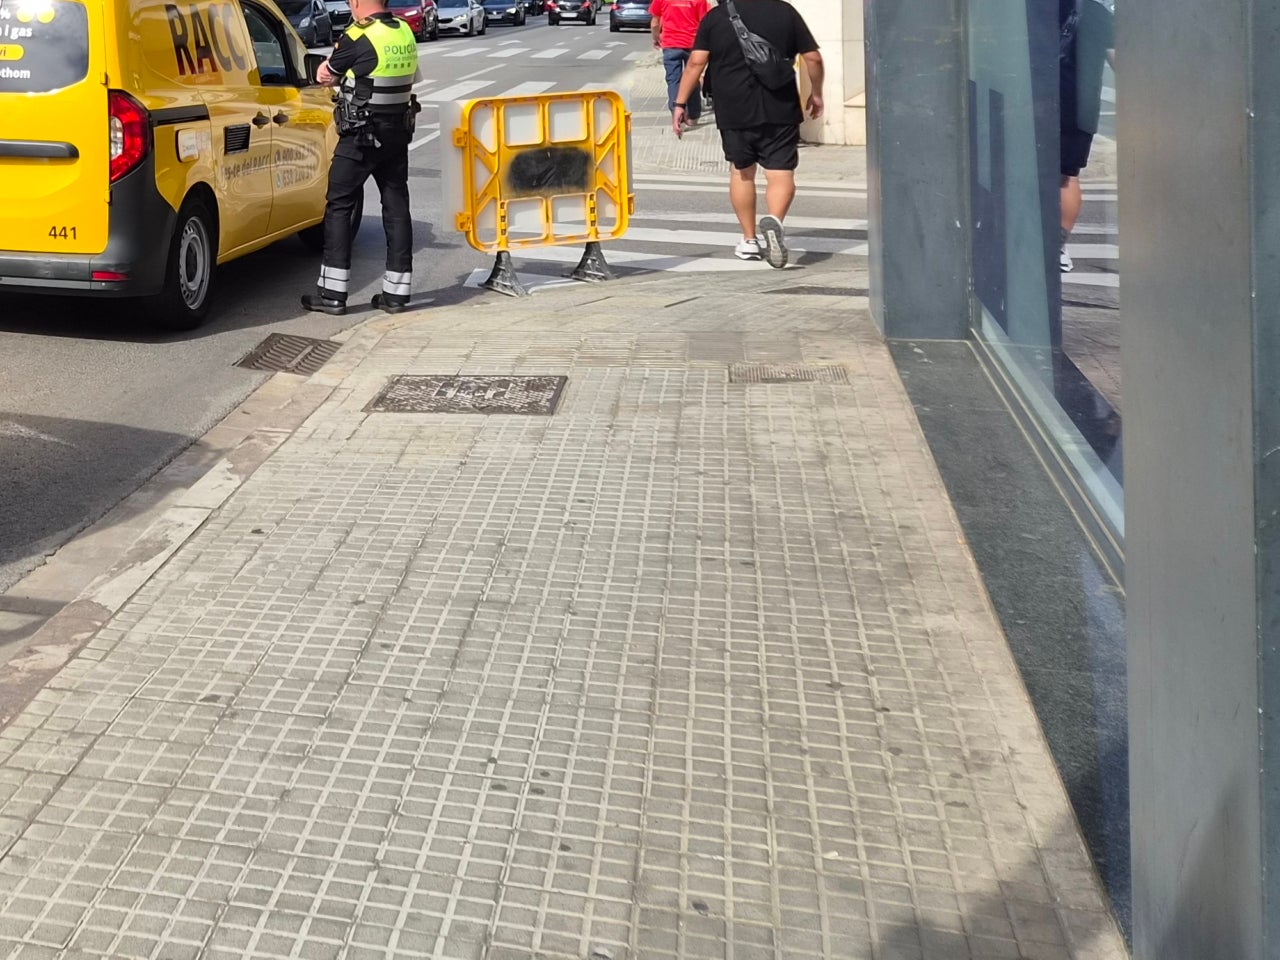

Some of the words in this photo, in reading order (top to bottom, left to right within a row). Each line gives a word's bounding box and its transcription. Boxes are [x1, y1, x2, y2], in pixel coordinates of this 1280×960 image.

[10, 25, 33, 40] gas
[165, 3, 247, 76] RACC
[48, 226, 78, 240] 441
